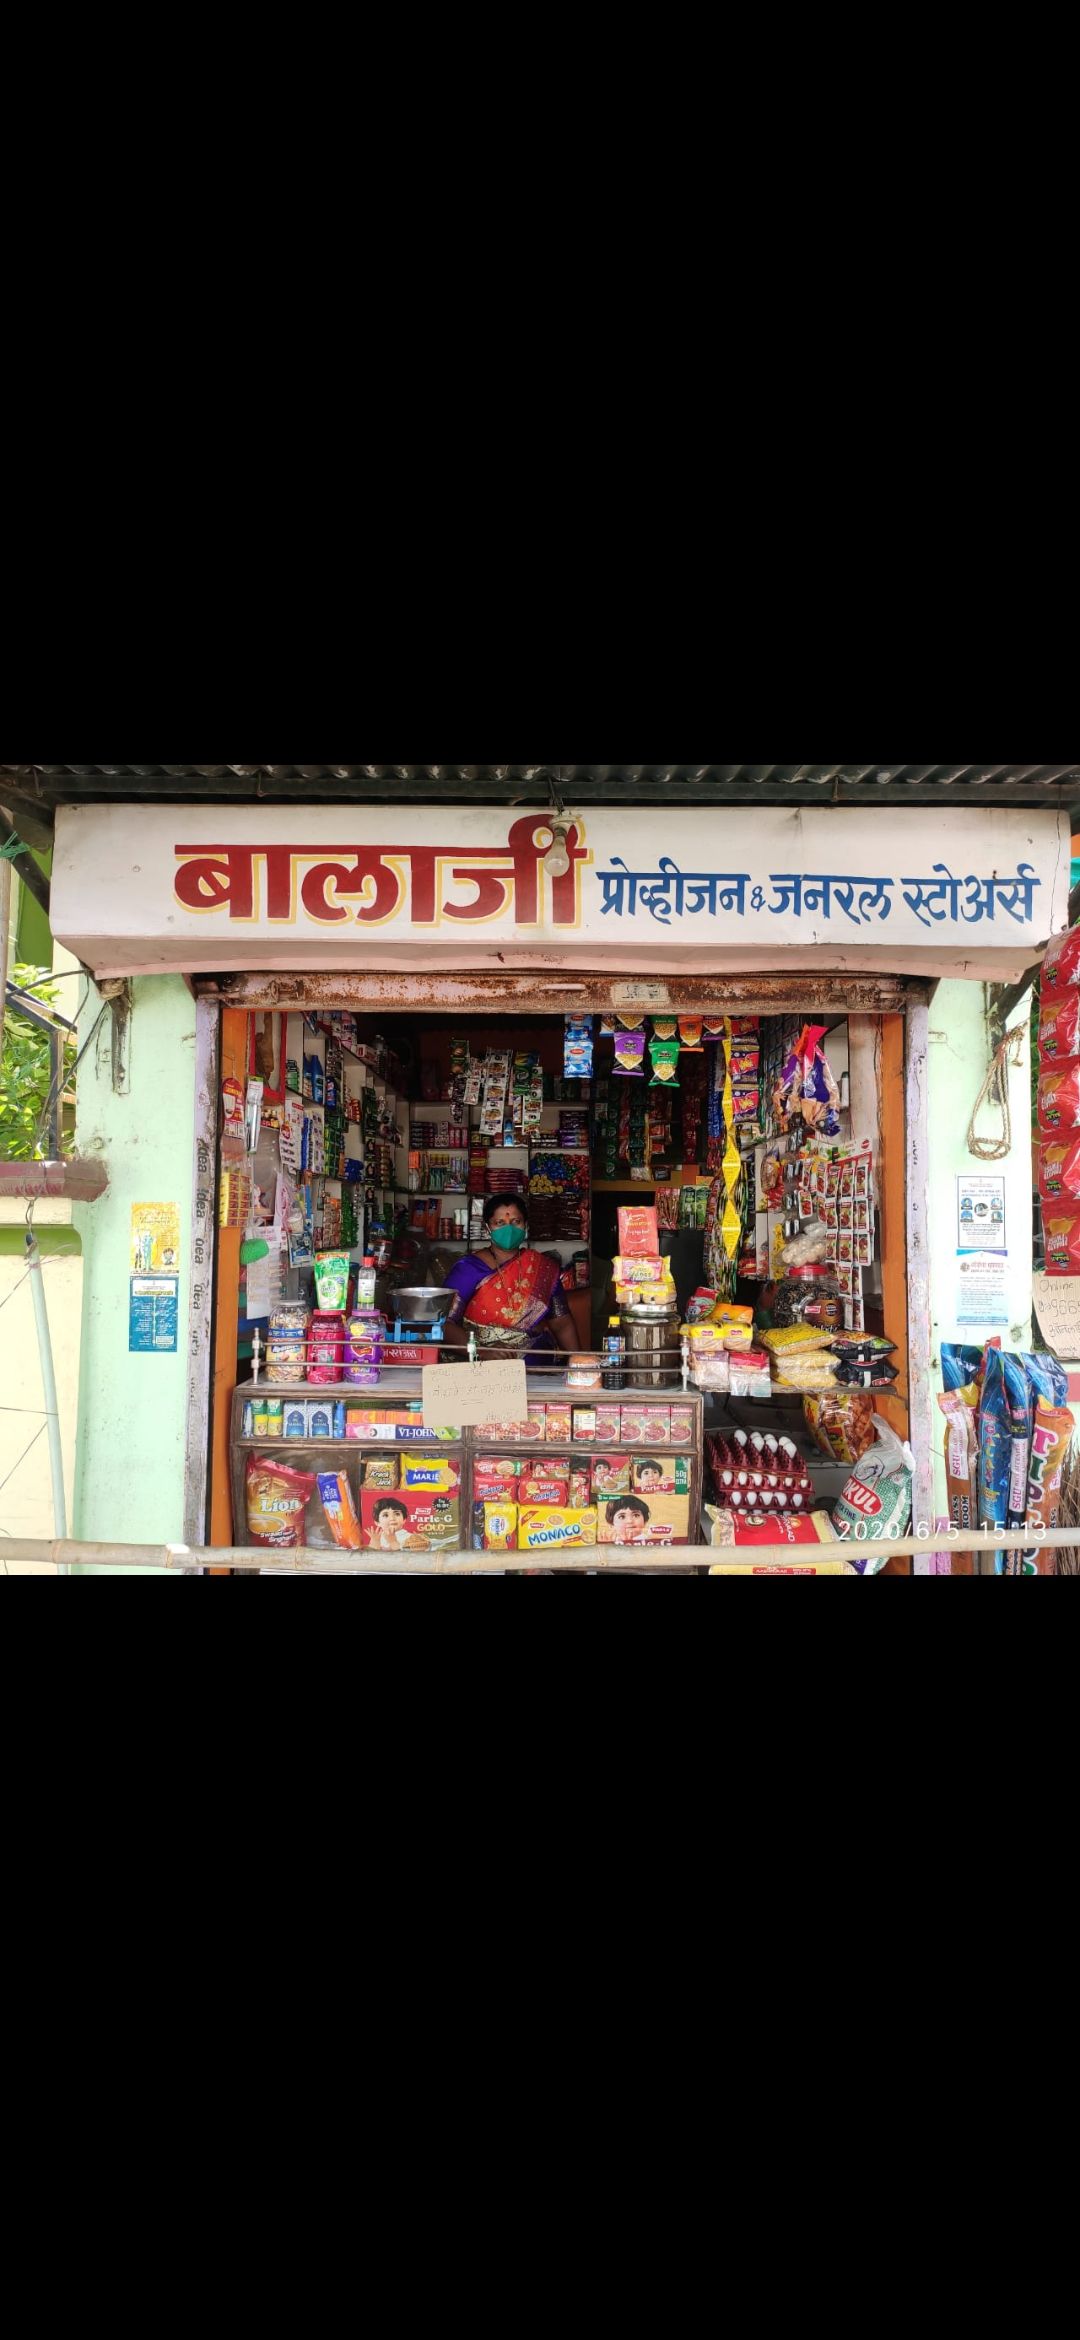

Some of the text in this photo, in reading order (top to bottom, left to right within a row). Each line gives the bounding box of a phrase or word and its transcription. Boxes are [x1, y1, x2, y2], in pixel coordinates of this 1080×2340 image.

[174, 814, 592, 927] बालाजी
[750, 885, 766, 912] &
[769, 873, 894, 925] जनरल
[900, 863, 1041, 927] स्टोअर्स
[413, 1472, 439, 1481] MARIE
[261, 1497, 300, 1513] Lion
[1012, 1487, 1021, 1509] SGU
[409, 1514, 453, 1523] Parle-G
[416, 1523, 445, 1532] GOLD
[528, 1524, 581, 1546] MONACO
